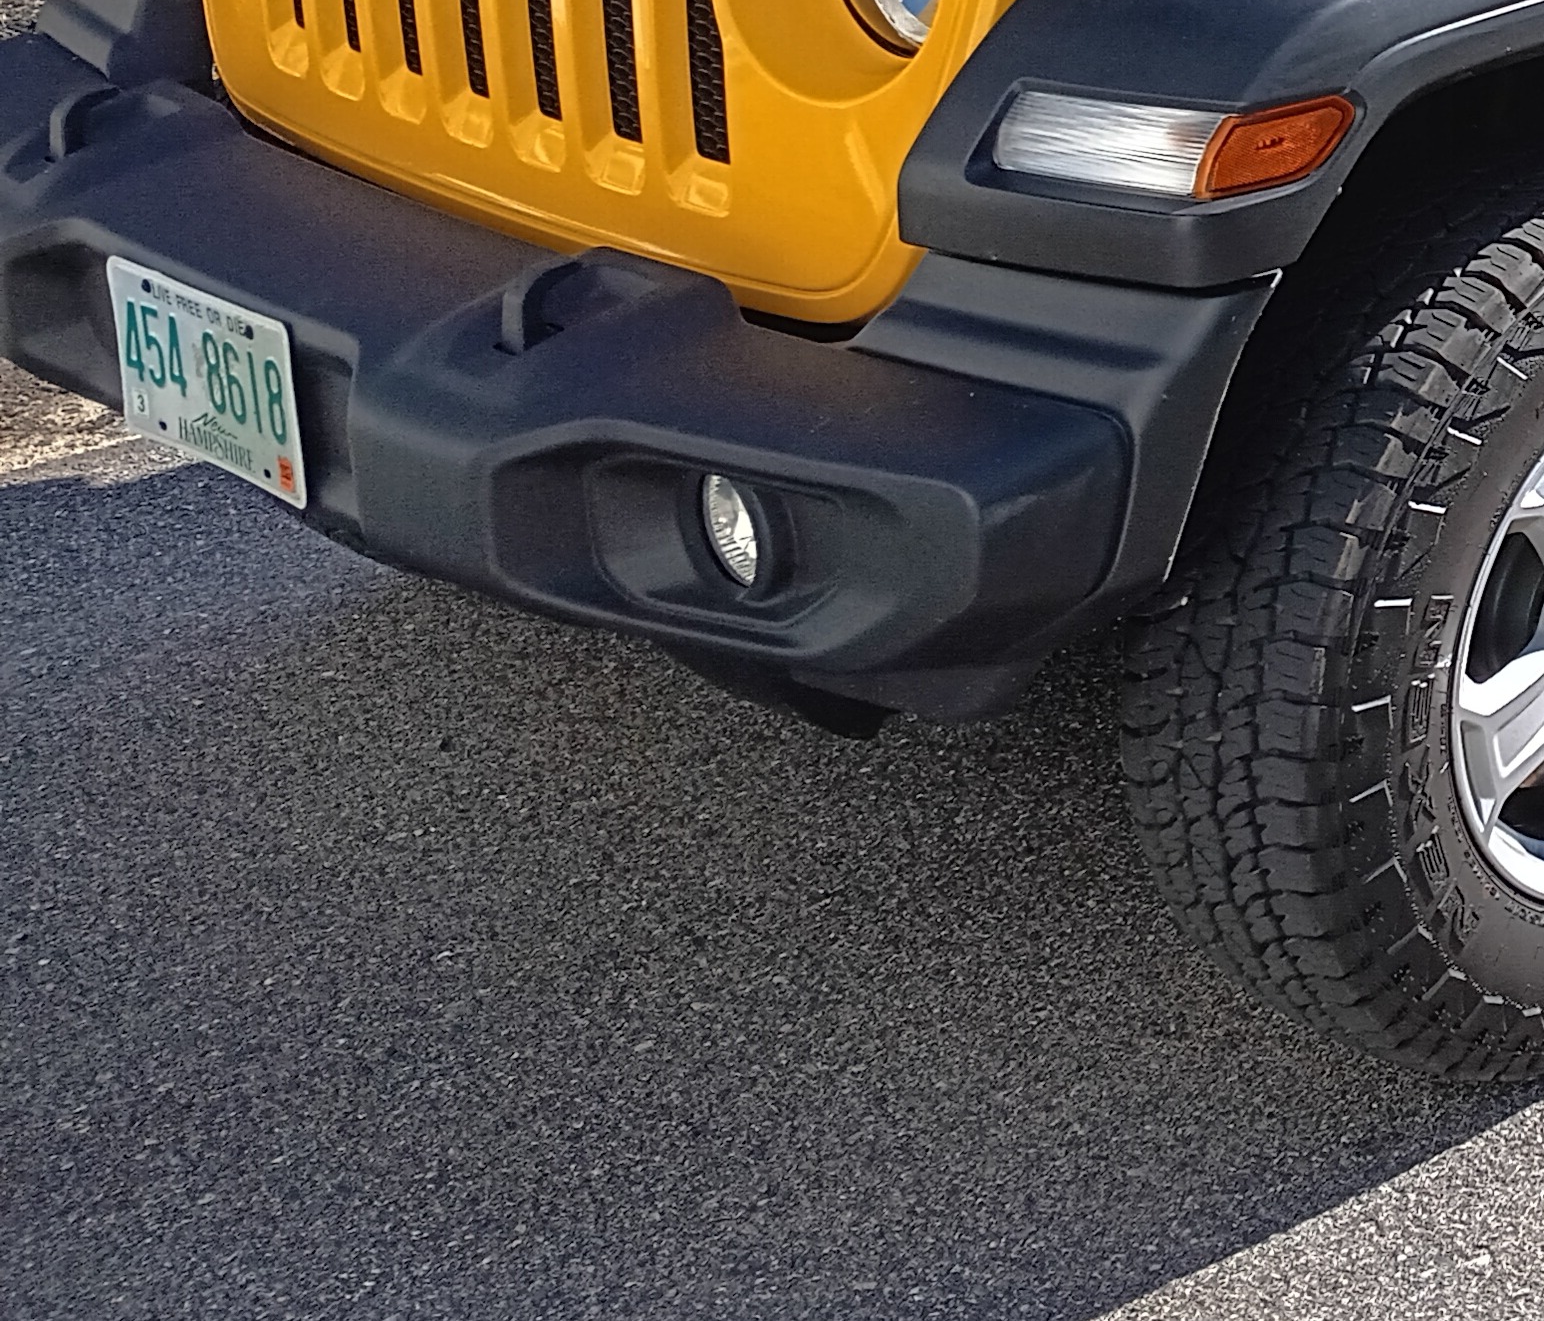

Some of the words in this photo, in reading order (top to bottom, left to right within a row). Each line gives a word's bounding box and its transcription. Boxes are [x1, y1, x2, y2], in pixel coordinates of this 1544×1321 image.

[151, 283, 173, 306] LIVE
[176, 294, 203, 319] FREE
[206, 307, 222, 327] OR
[227, 315, 245, 336] DIE
[126, 299, 187, 398] 454
[202, 330, 287, 445] 8618
[136, 394, 147, 413] 3
[178, 416, 254, 469] HAMPSHIRE
[1405, 594, 1480, 951] NEXEN
